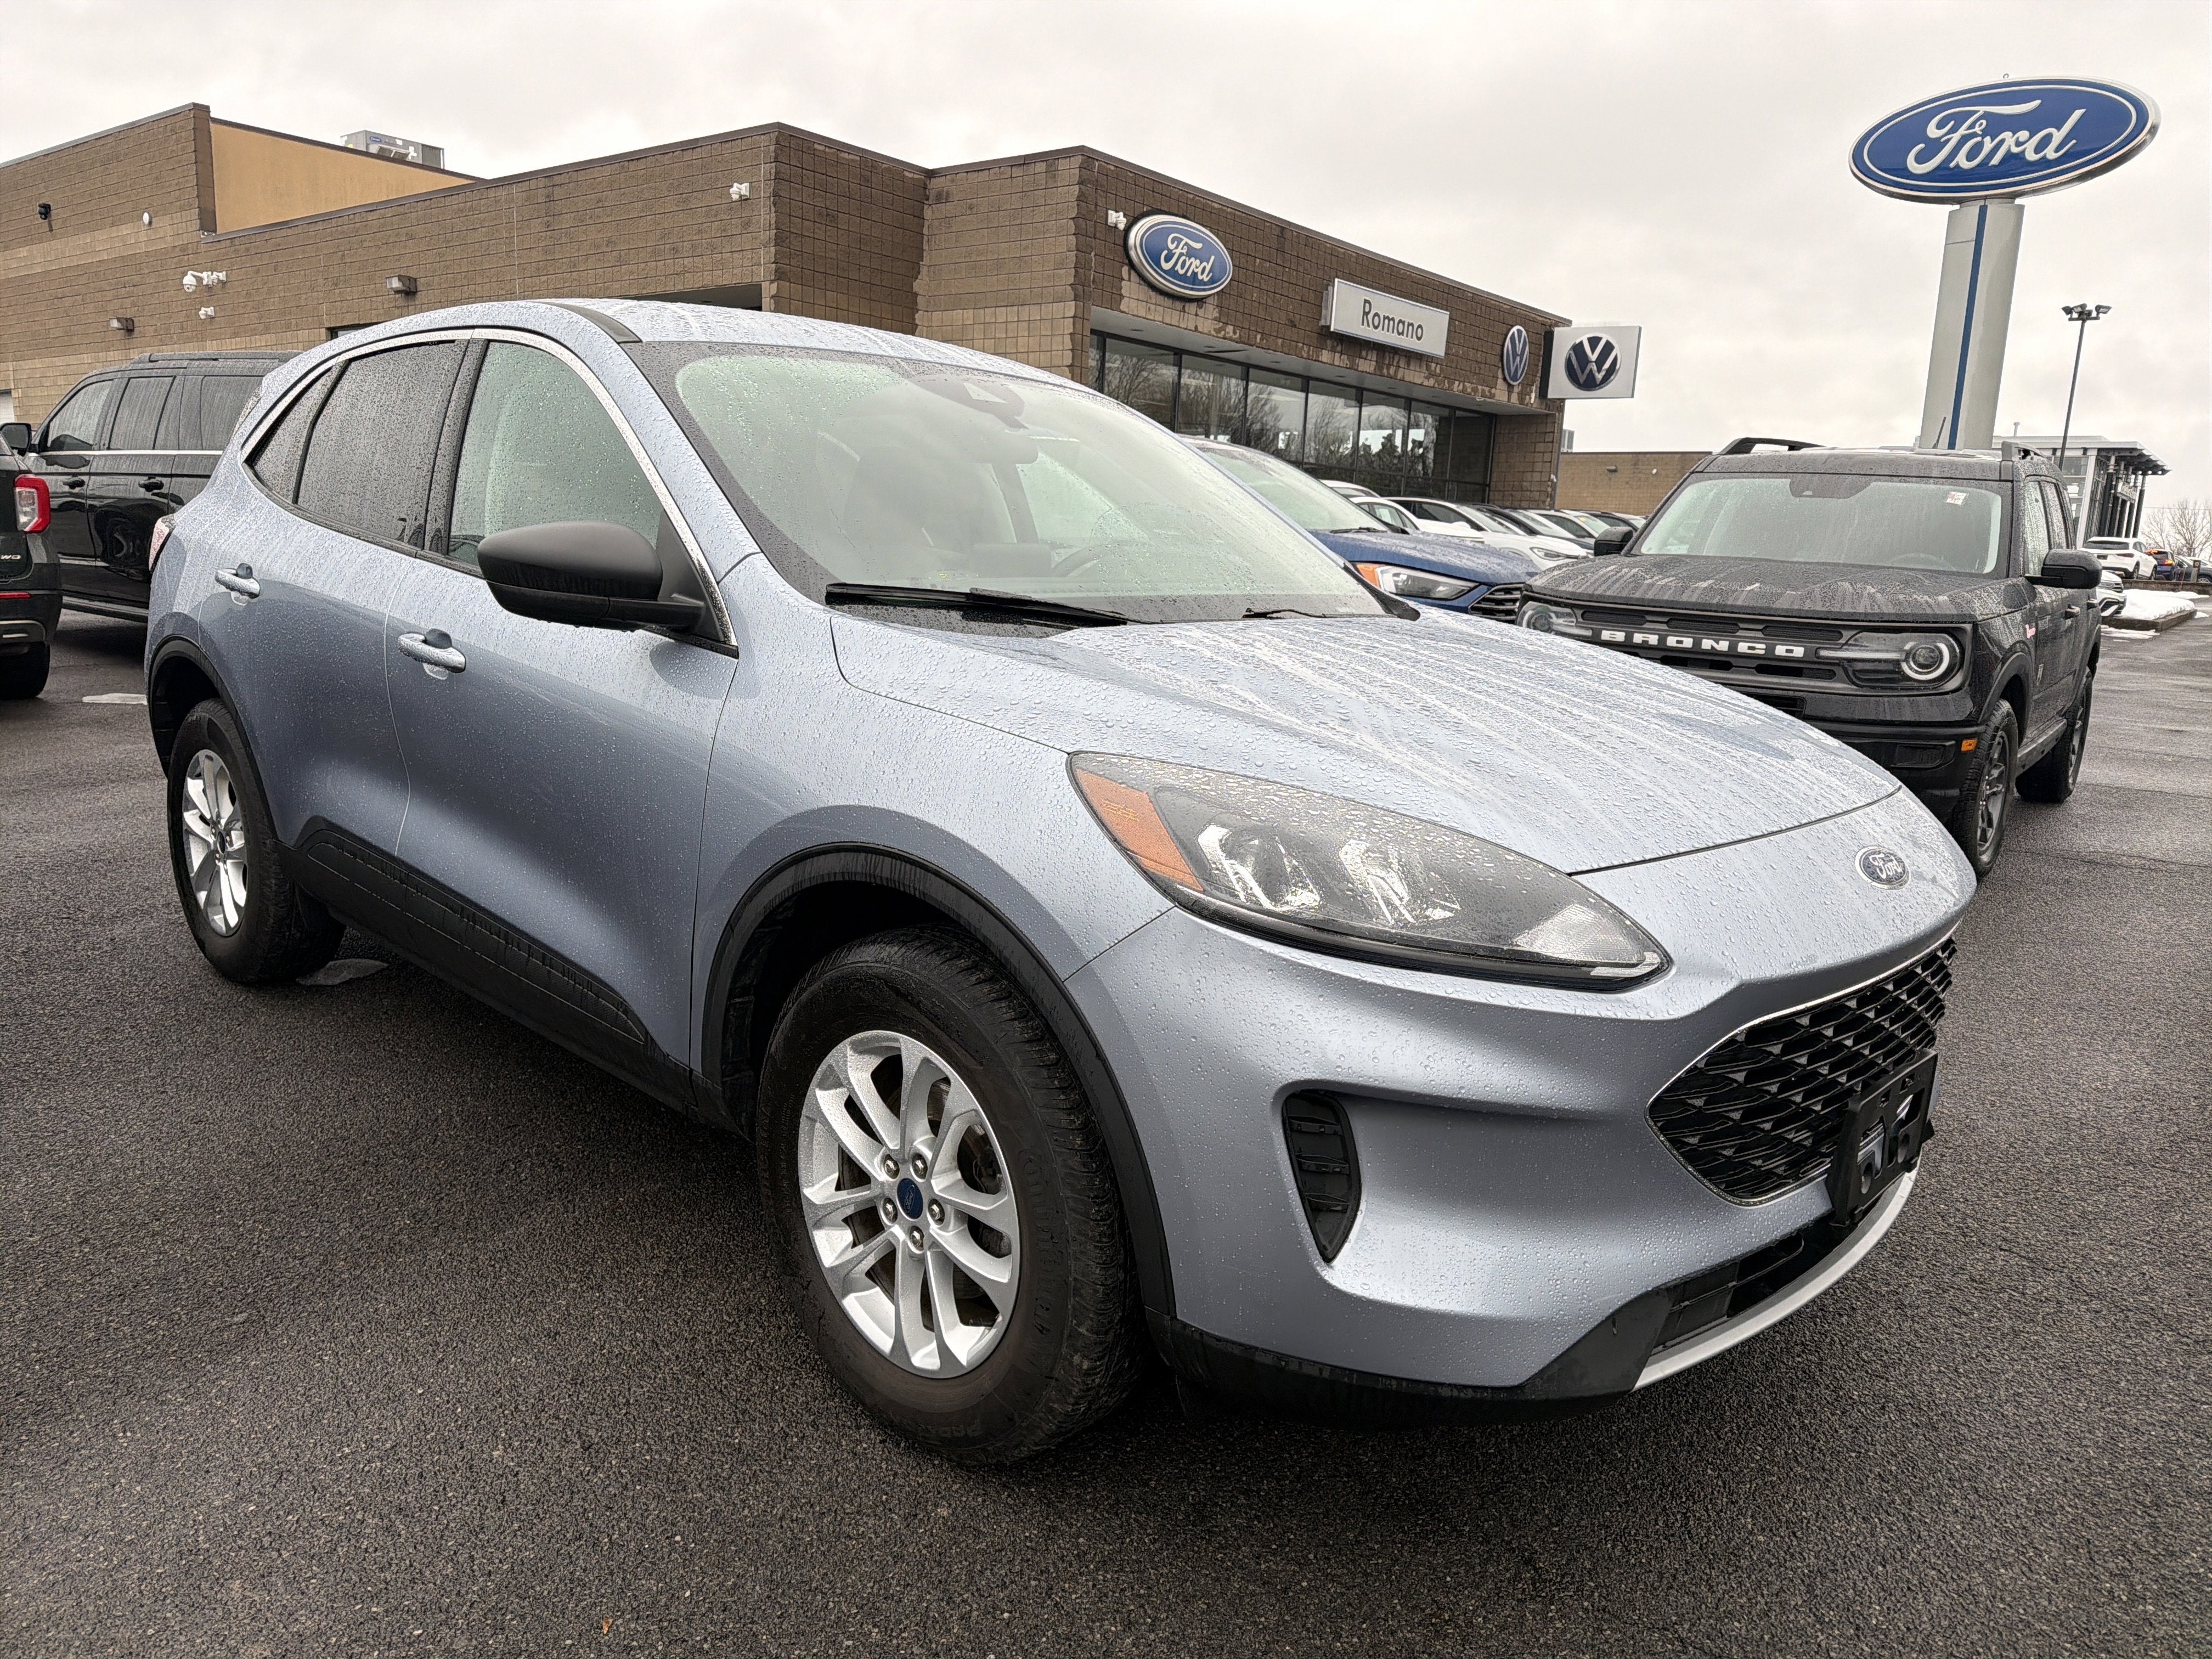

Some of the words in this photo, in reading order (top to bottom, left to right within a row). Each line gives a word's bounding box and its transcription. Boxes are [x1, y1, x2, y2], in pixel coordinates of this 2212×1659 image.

[1906, 99, 2086, 174] Ford
[1160, 233, 1215, 281] Ford
[1361, 298, 1424, 341] Romano
[1601, 630, 1805, 657] BRONCO
[1869, 853, 1903, 879] Ford
